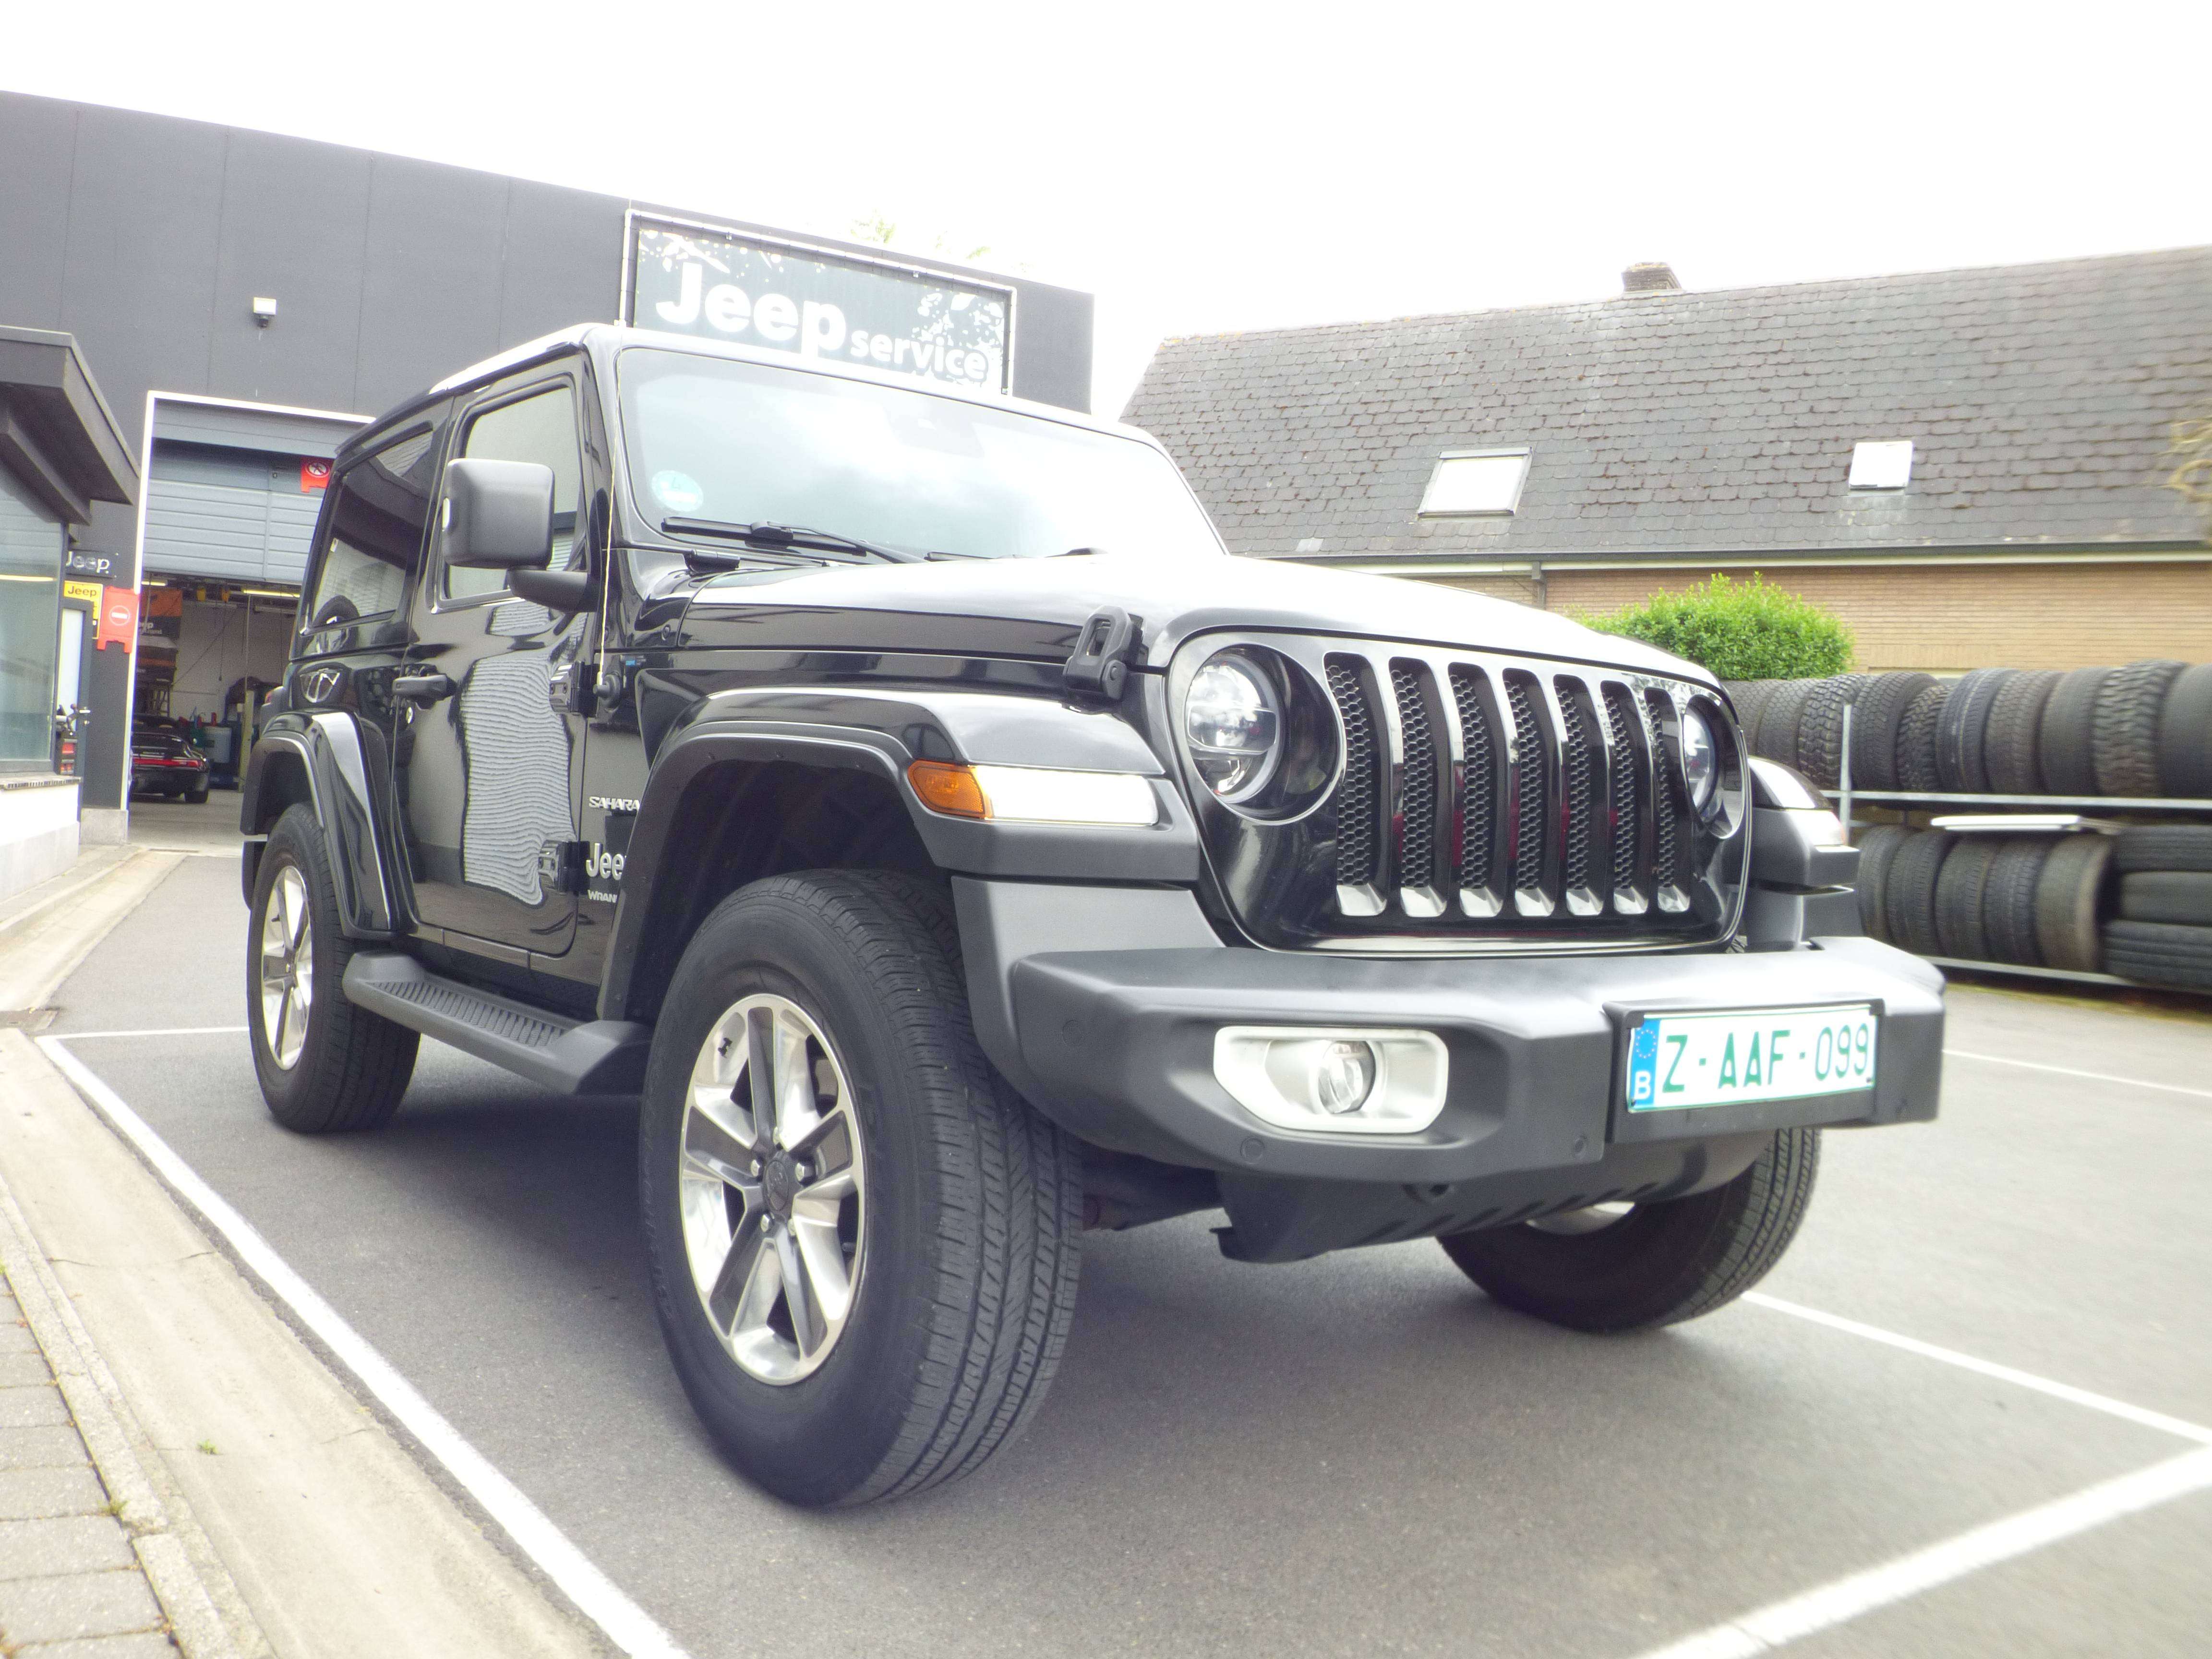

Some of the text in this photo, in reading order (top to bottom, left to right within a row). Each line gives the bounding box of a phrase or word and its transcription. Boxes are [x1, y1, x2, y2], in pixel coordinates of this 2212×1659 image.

[655, 262, 988, 381] Jeep service
[65, 551, 110, 573] Jeep
[68, 586, 97, 598] Jeep
[589, 796, 640, 811] SAHARA
[586, 843, 626, 880] Jee
[1634, 1070, 1651, 1100] B
